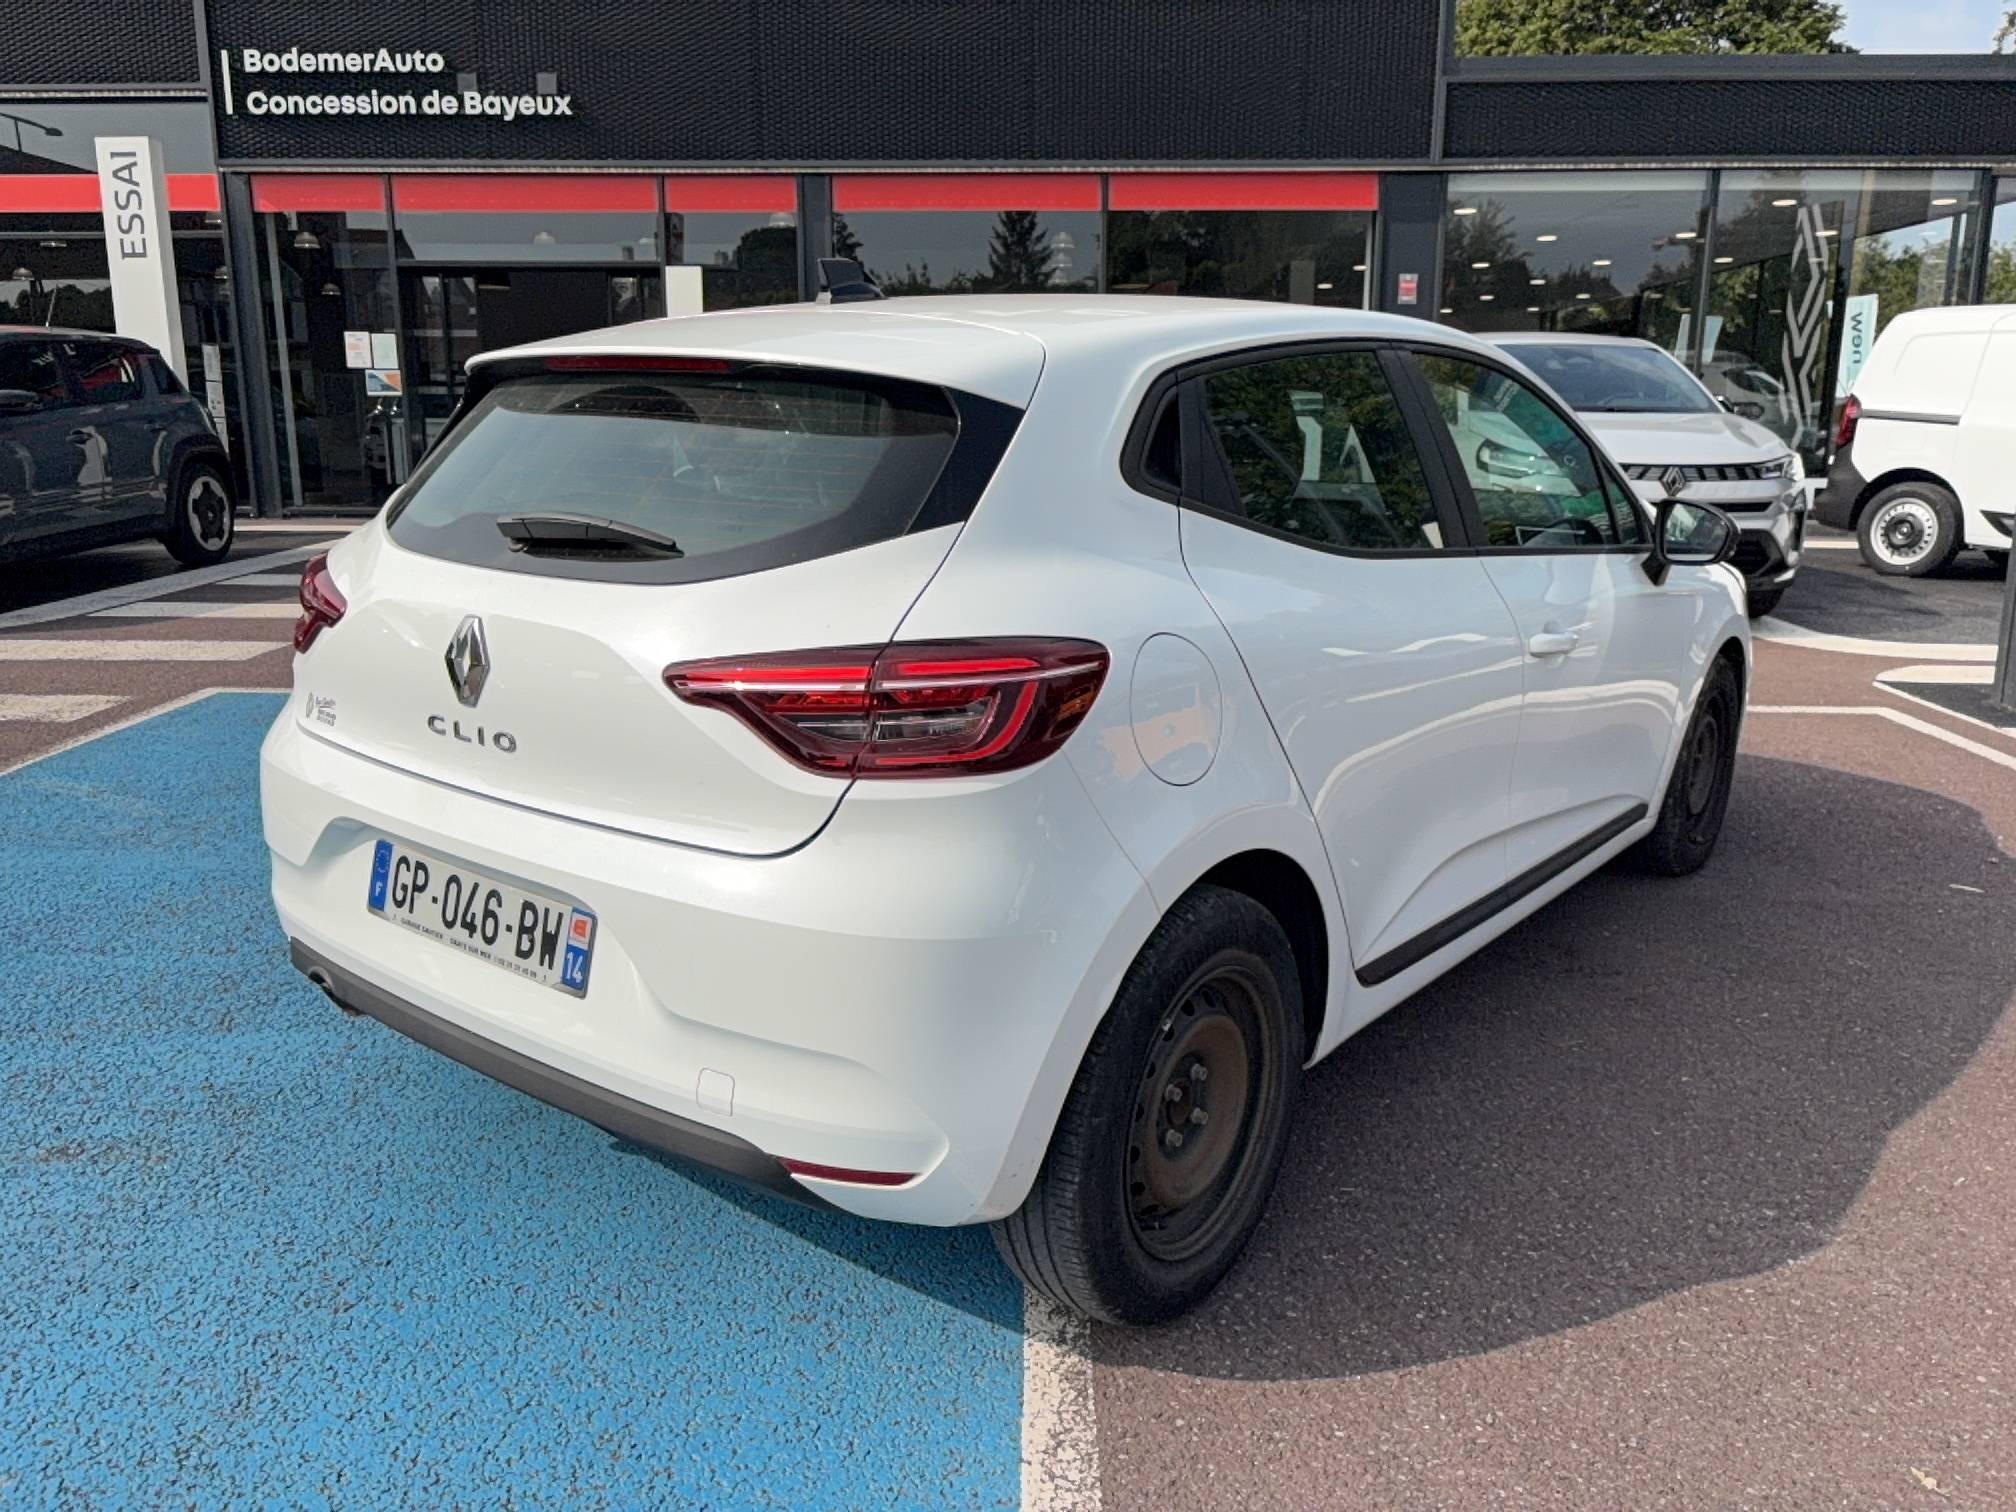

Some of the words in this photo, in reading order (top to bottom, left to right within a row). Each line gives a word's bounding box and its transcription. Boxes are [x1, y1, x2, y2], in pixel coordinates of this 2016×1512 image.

[243, 47, 445, 73] BodemerAuto
[246, 90, 417, 116] Concession
[421, 90, 459, 116] de
[462, 91, 573, 121] Bayeux
[110, 151, 148, 260] ESSAI
[427, 714, 517, 753] CLIO
[375, 881, 384, 897] F
[392, 855, 564, 970] GP-046-BW
[565, 951, 584, 983] 14
